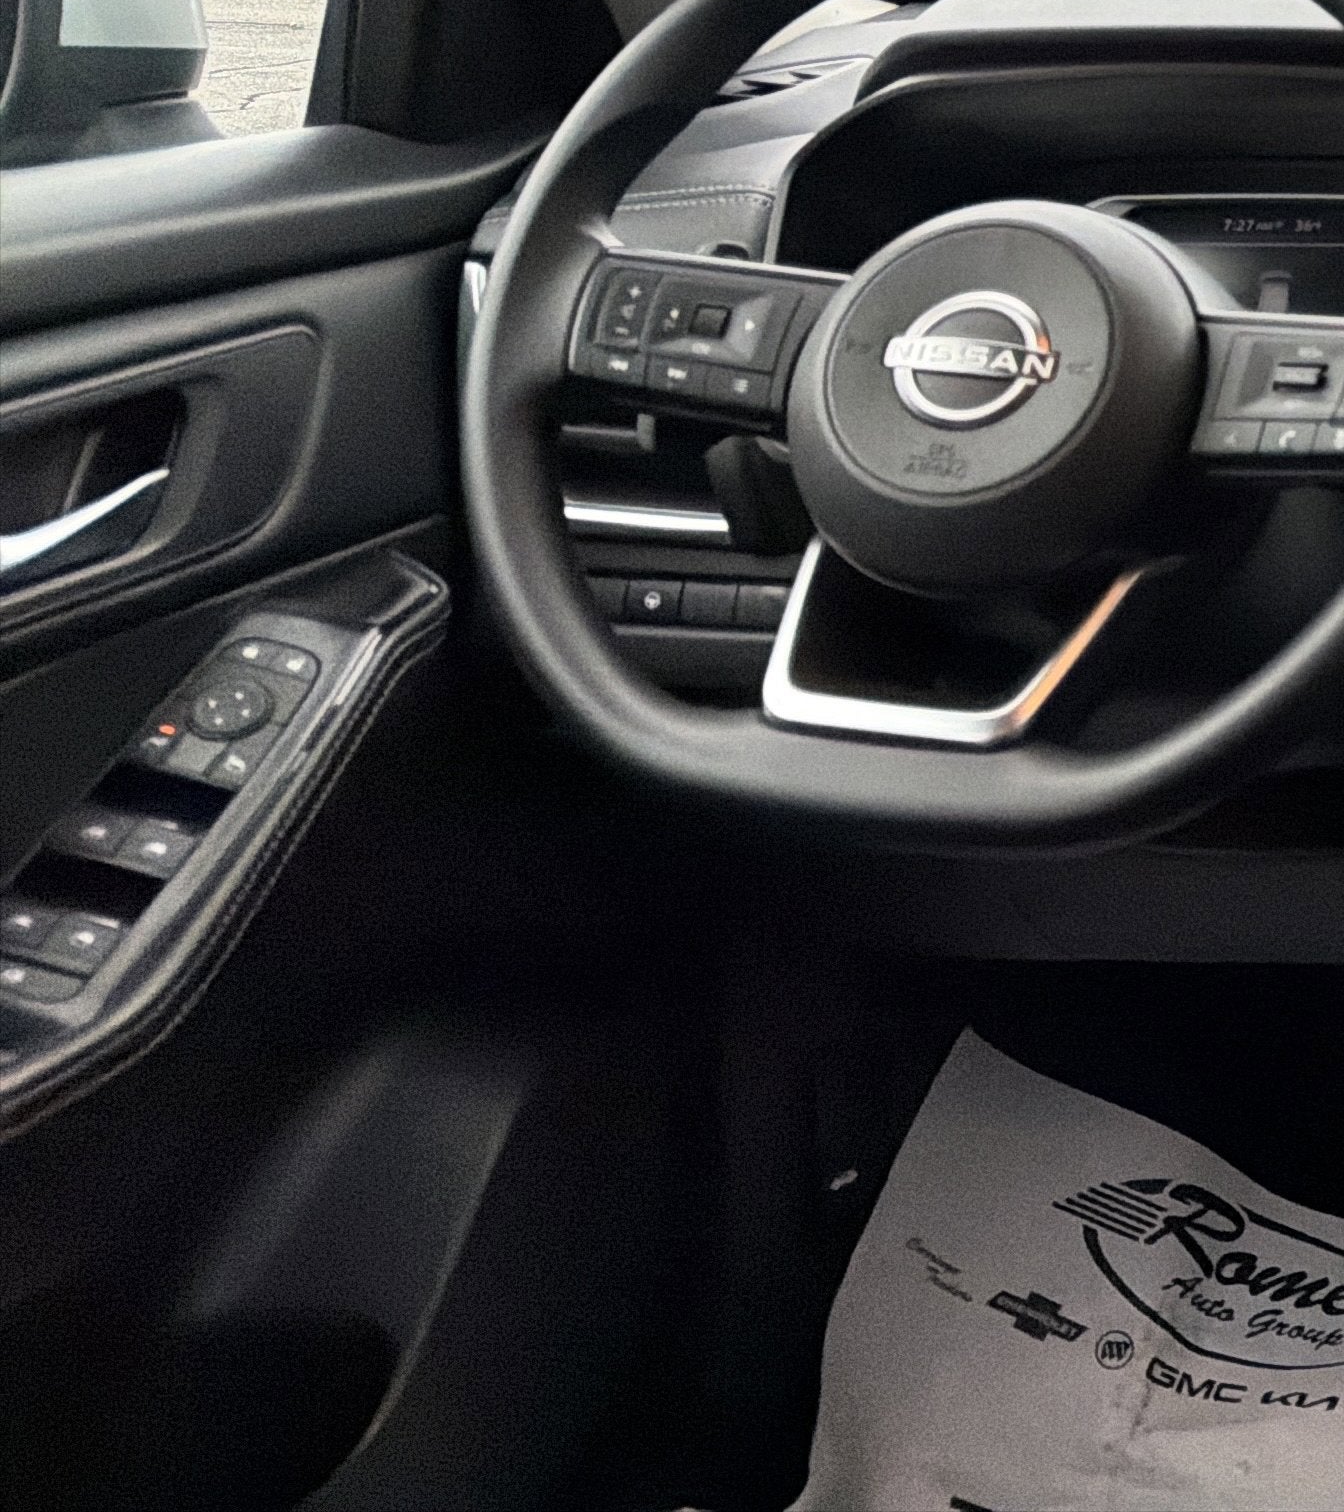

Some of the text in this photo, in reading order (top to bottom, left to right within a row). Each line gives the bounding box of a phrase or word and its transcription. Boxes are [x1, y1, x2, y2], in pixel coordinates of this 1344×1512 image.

[893, 340, 1055, 380] NISSAN
[1161, 1274, 1344, 1350] Auto Group
[1145, 1358, 1249, 1404] GMC
